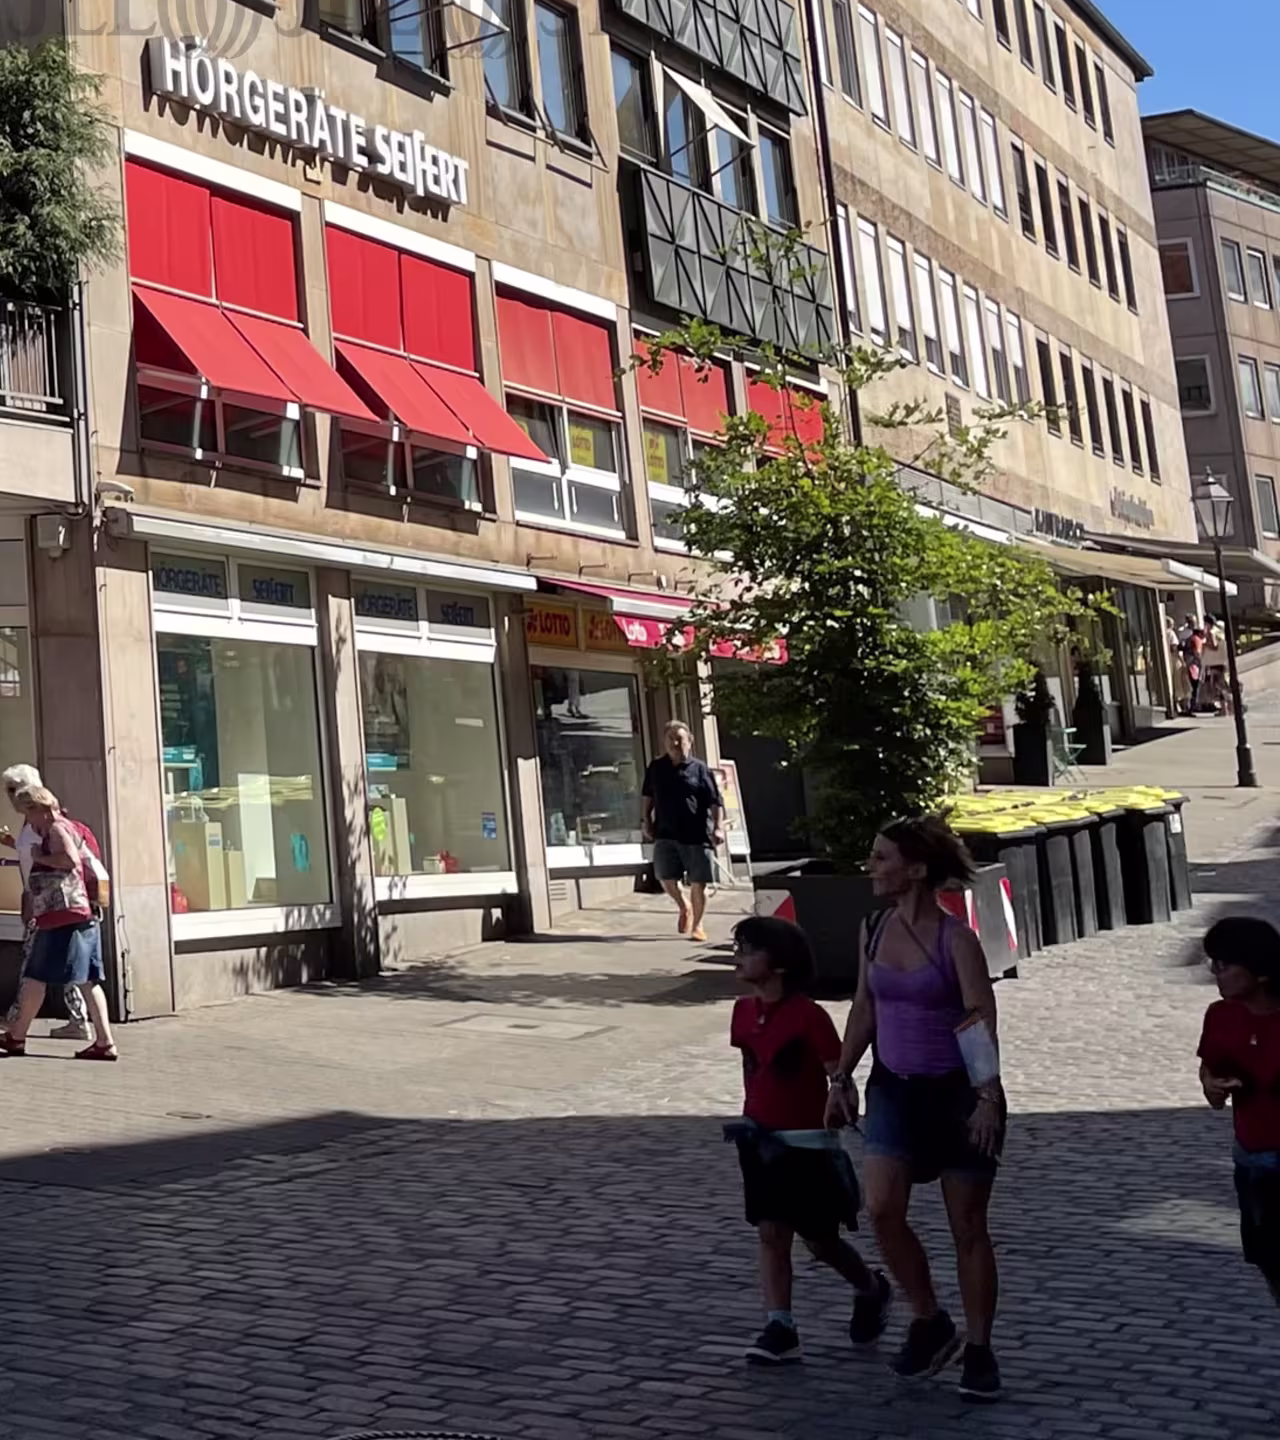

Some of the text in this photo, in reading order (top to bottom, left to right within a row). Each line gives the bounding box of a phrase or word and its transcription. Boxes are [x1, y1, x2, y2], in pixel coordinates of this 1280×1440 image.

[160, 35, 370, 168] HÖRGERÄTE
[538, 610, 571, 636] LOTTO
[622, 617, 648, 641] Lotto
